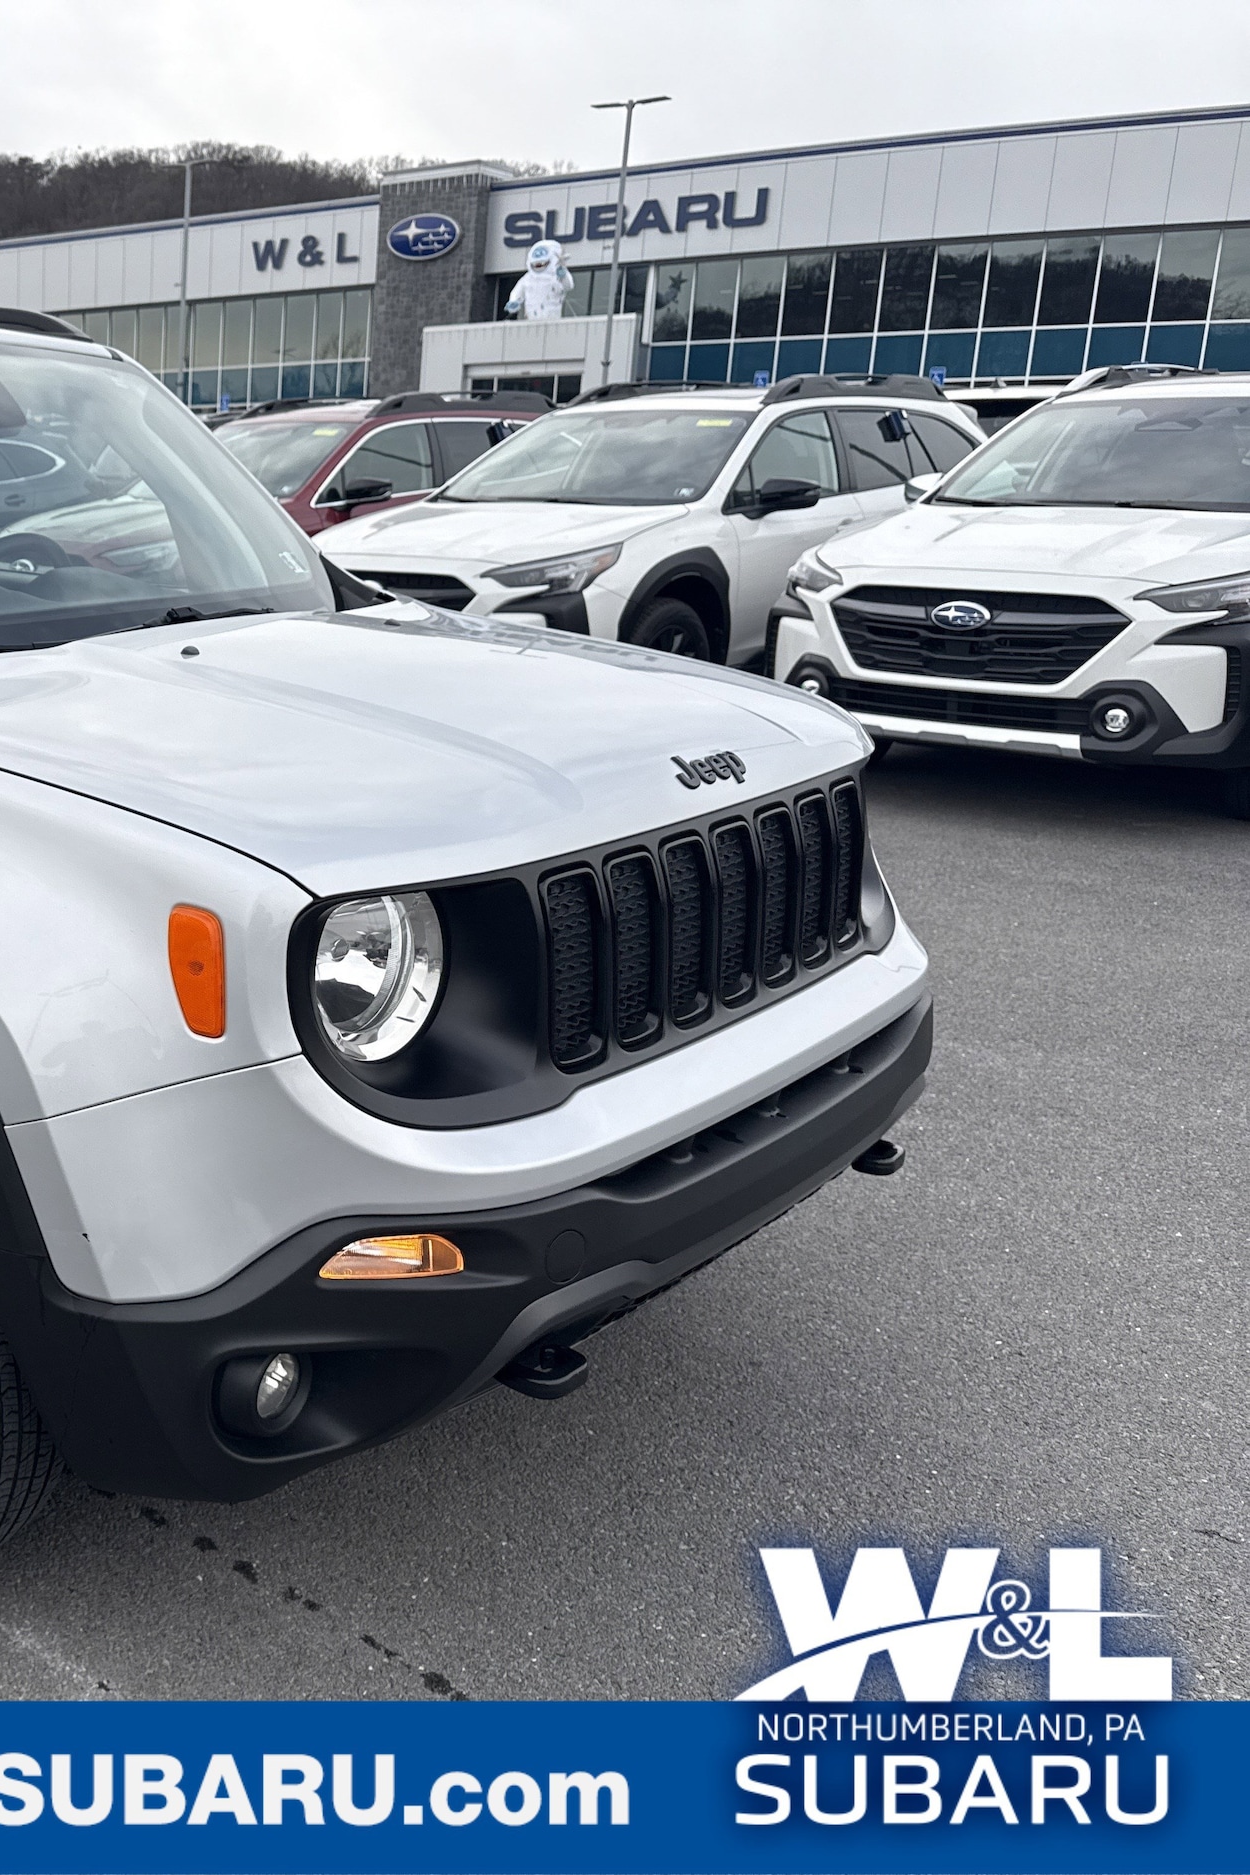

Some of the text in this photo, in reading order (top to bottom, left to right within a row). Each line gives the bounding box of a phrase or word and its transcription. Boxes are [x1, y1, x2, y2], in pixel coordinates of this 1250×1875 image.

[503, 187, 769, 248] SUBARU
[251, 231, 360, 272] W & L
[670, 751, 746, 789] Jeep
